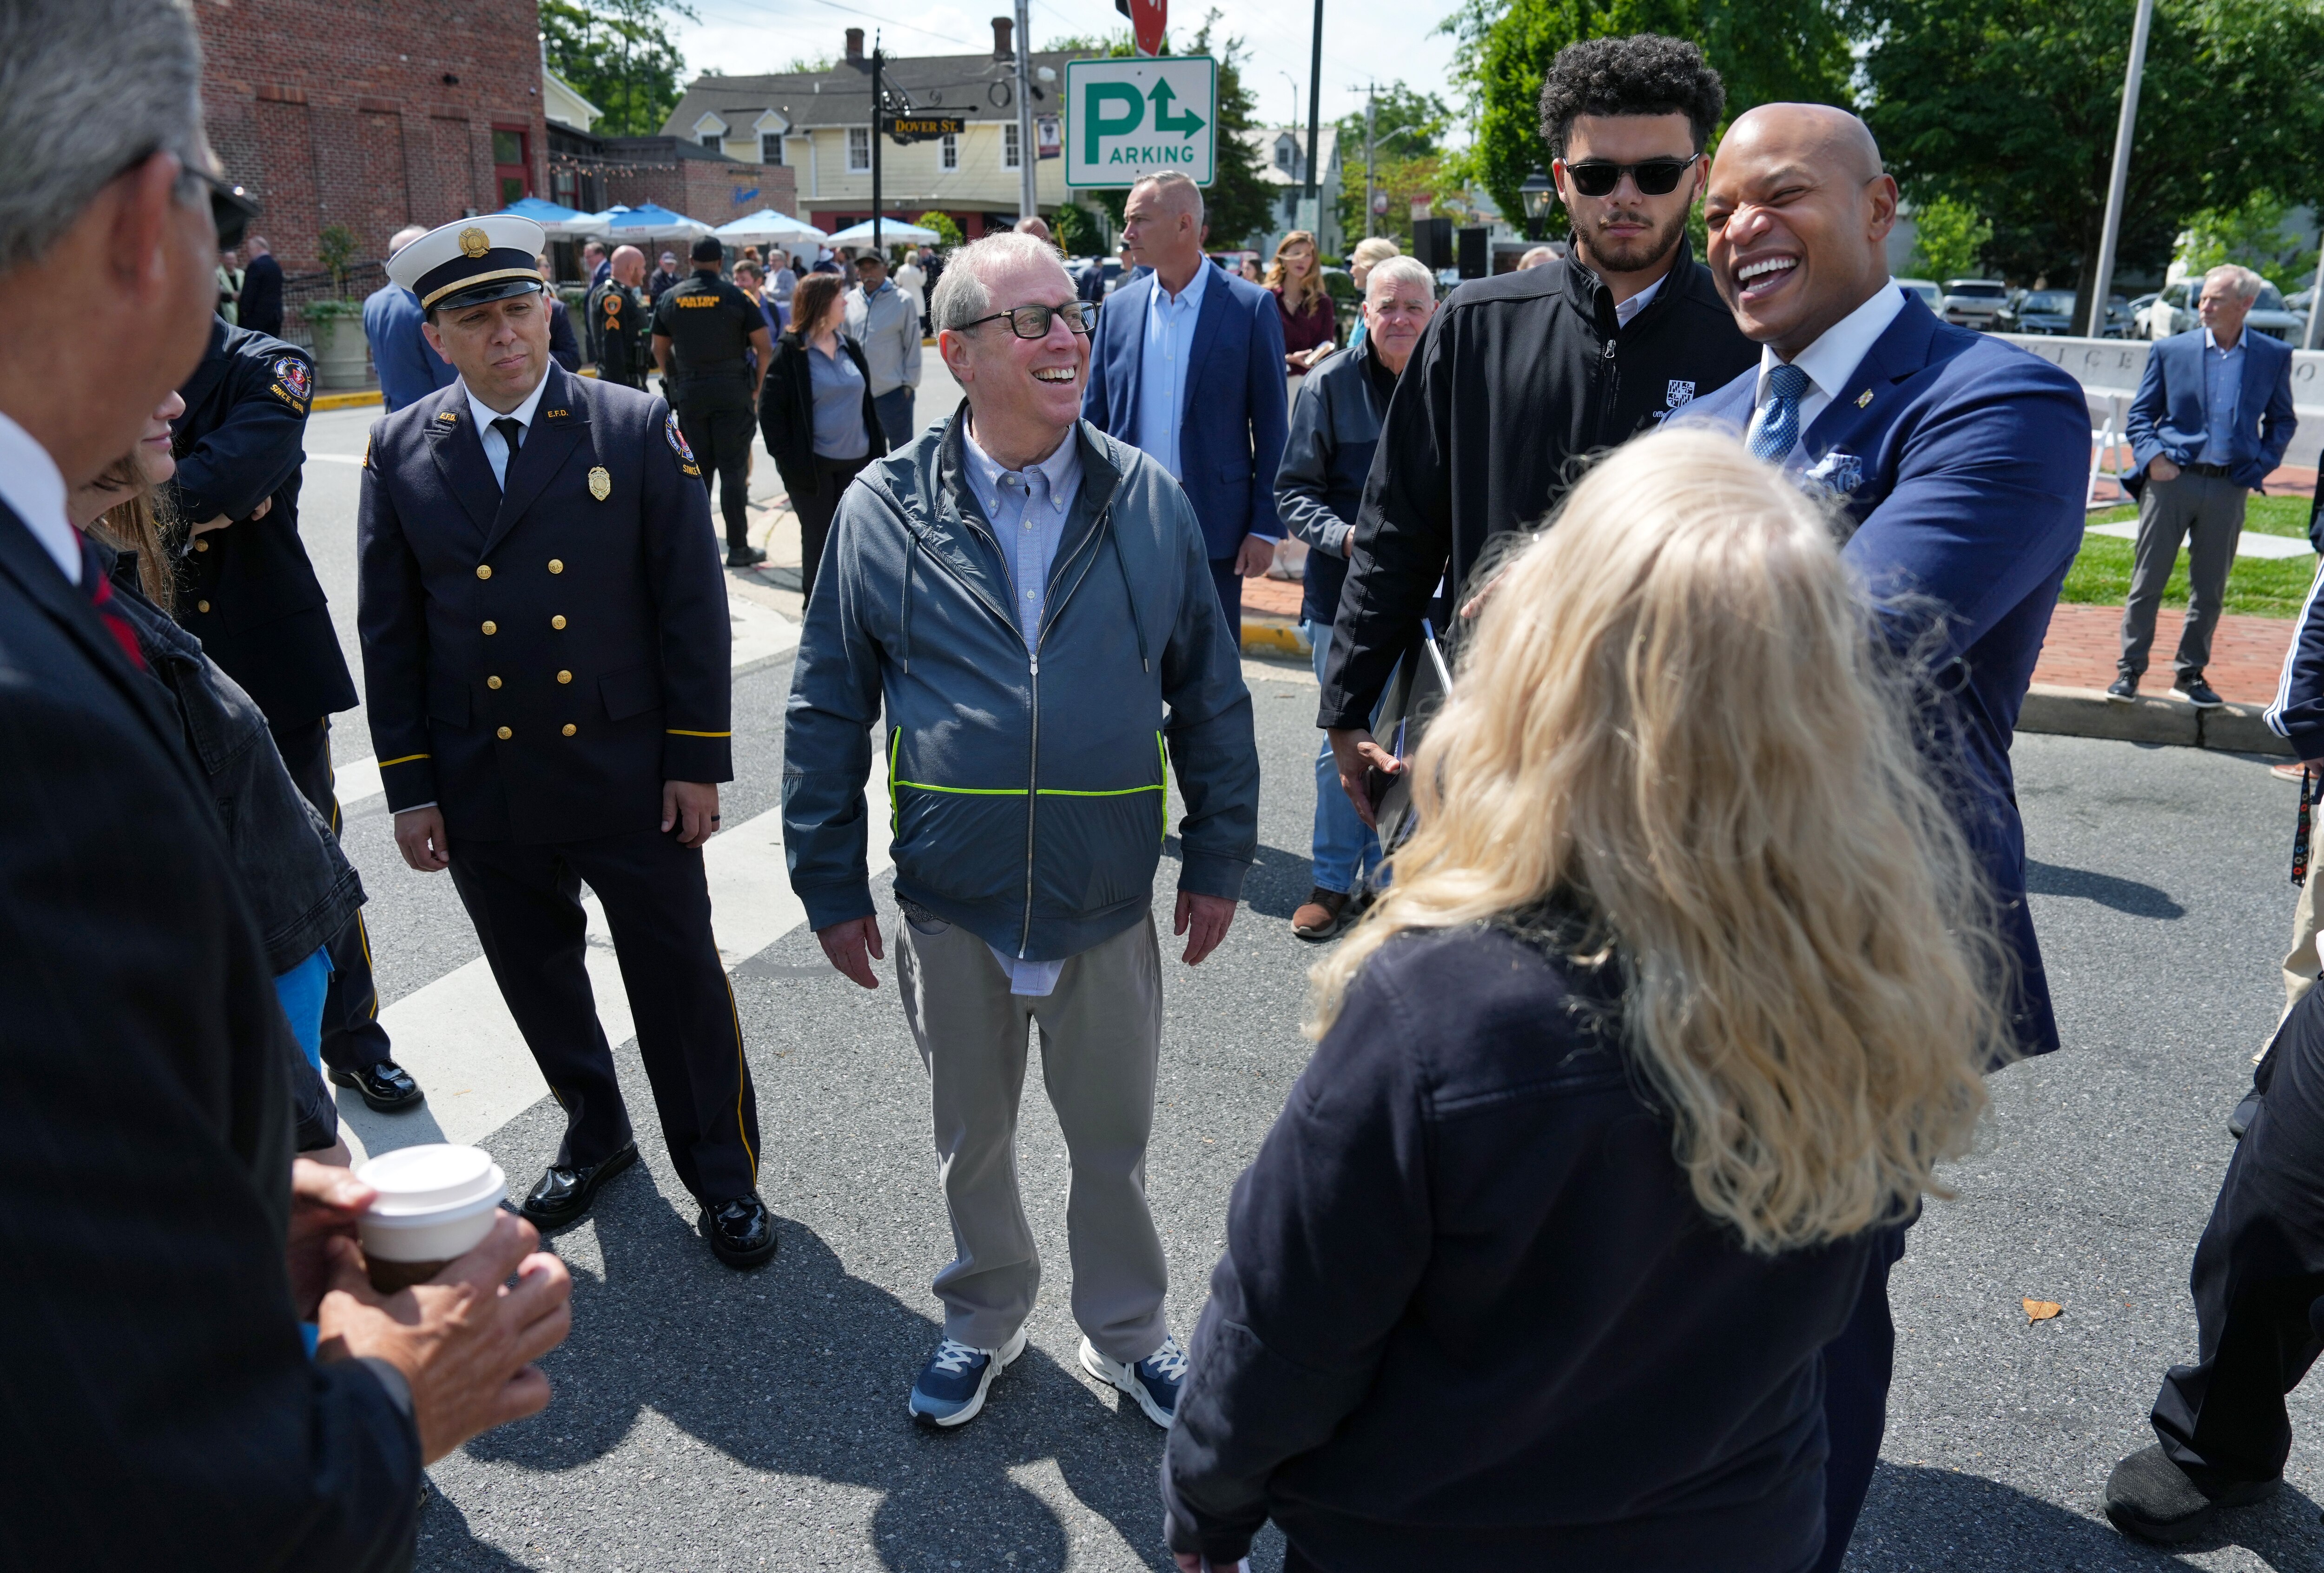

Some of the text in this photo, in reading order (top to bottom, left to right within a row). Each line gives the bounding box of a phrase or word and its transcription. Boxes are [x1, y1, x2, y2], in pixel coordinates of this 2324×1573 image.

[1085, 82, 1194, 165] PARKING
[270, 384, 292, 403] SINCE
[439, 413, 456, 421] E.F.D.
[683, 464, 698, 476] SINCE
